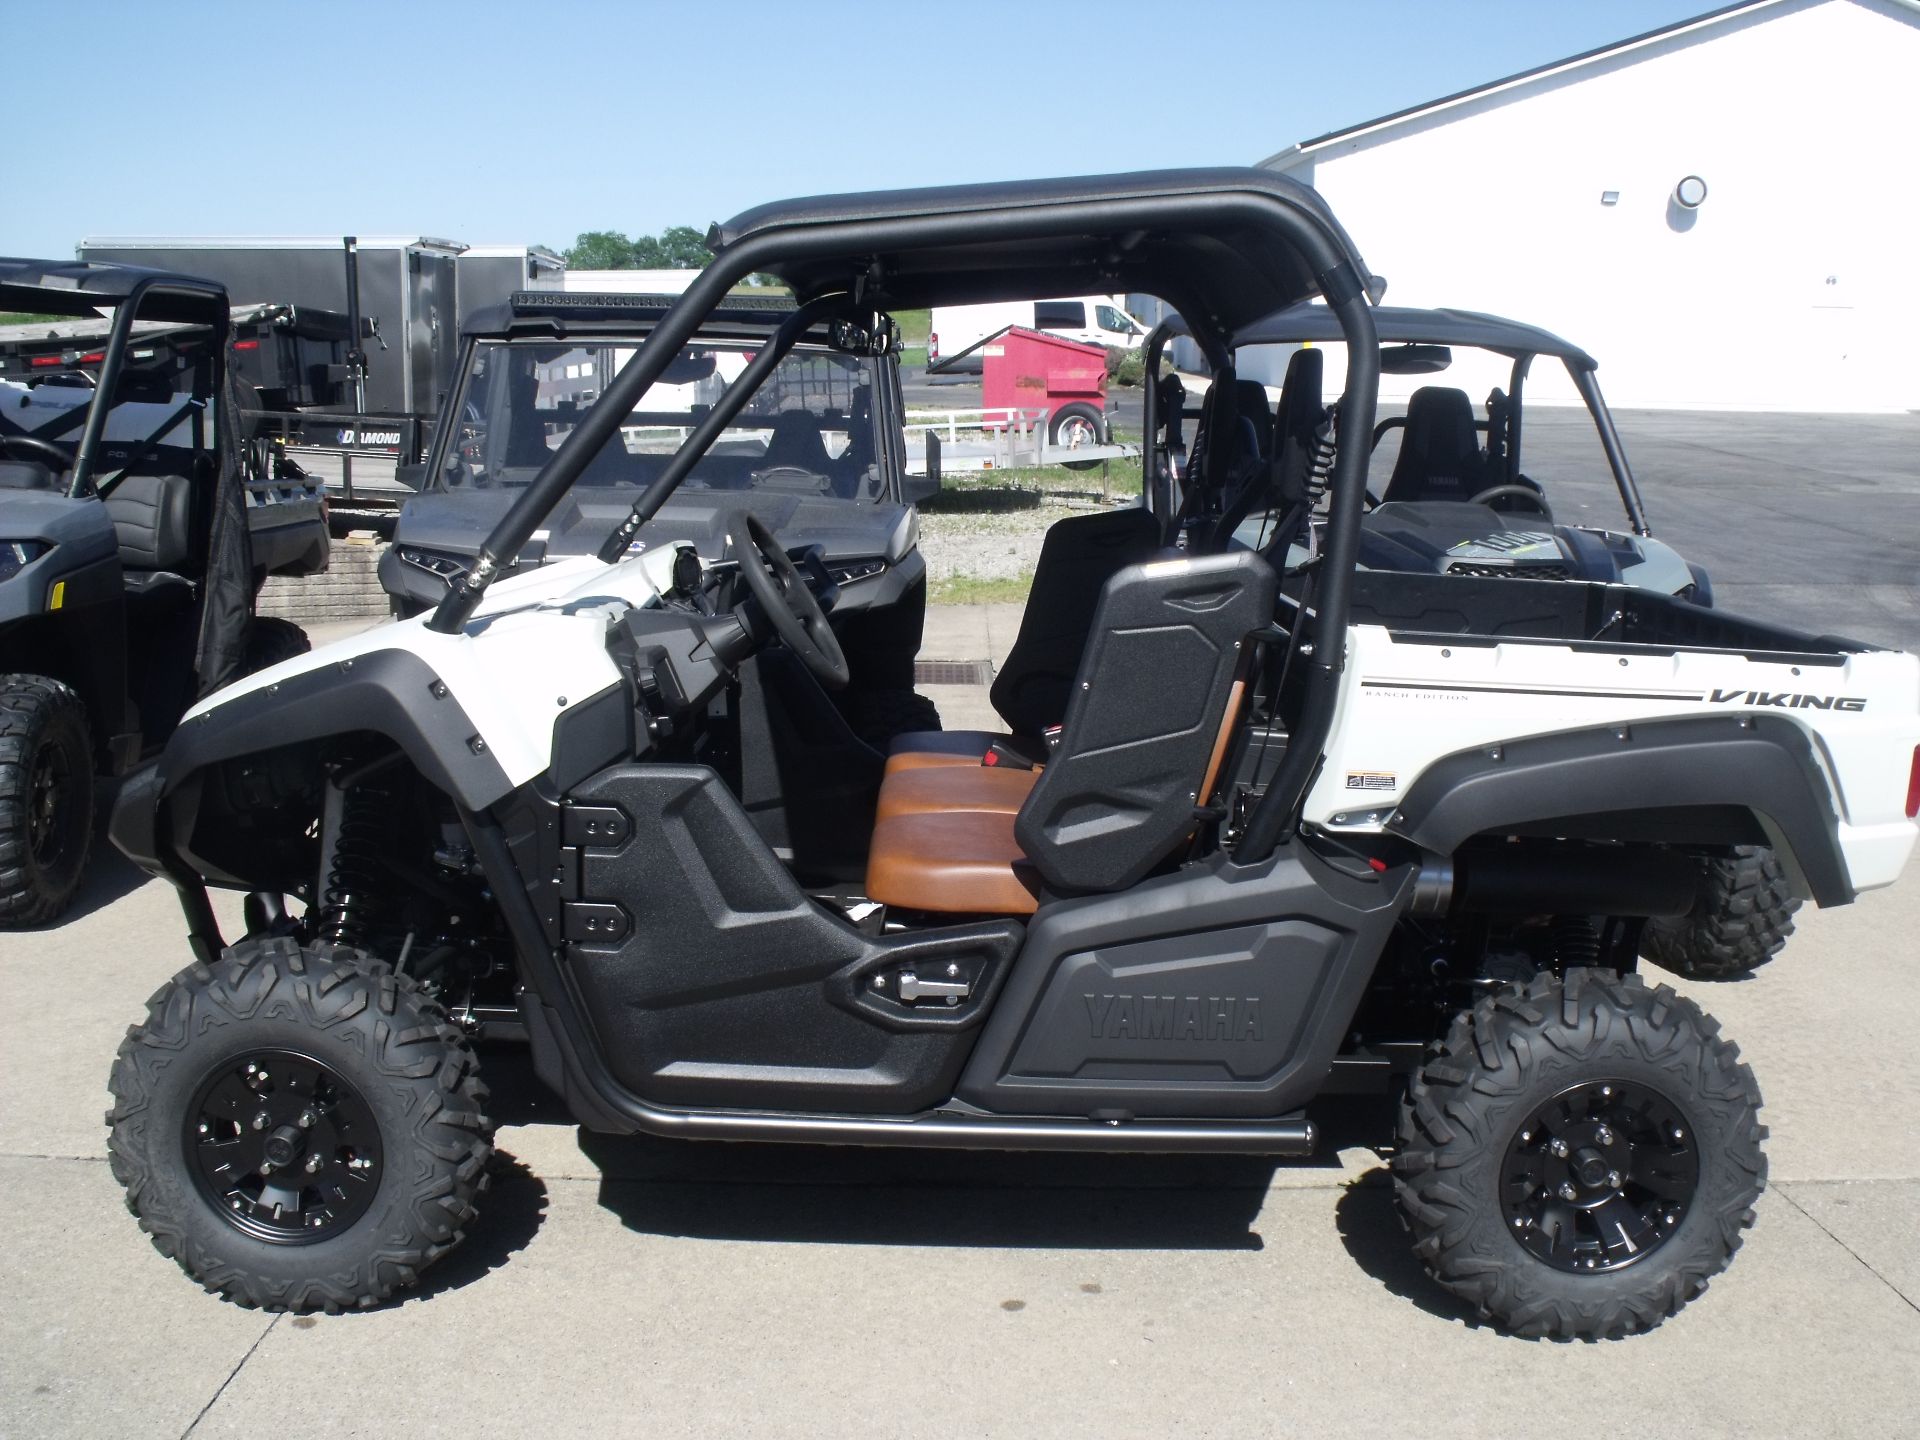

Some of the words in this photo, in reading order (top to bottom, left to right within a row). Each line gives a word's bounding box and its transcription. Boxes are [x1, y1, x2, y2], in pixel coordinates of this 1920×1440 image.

[343, 430, 400, 444] DAMOND
[1366, 691, 1409, 699] RANCH
[1415, 693, 1469, 701] EDITION
[1709, 688, 1867, 712] VIKING
[1084, 994, 1264, 1041] YAMAHA
